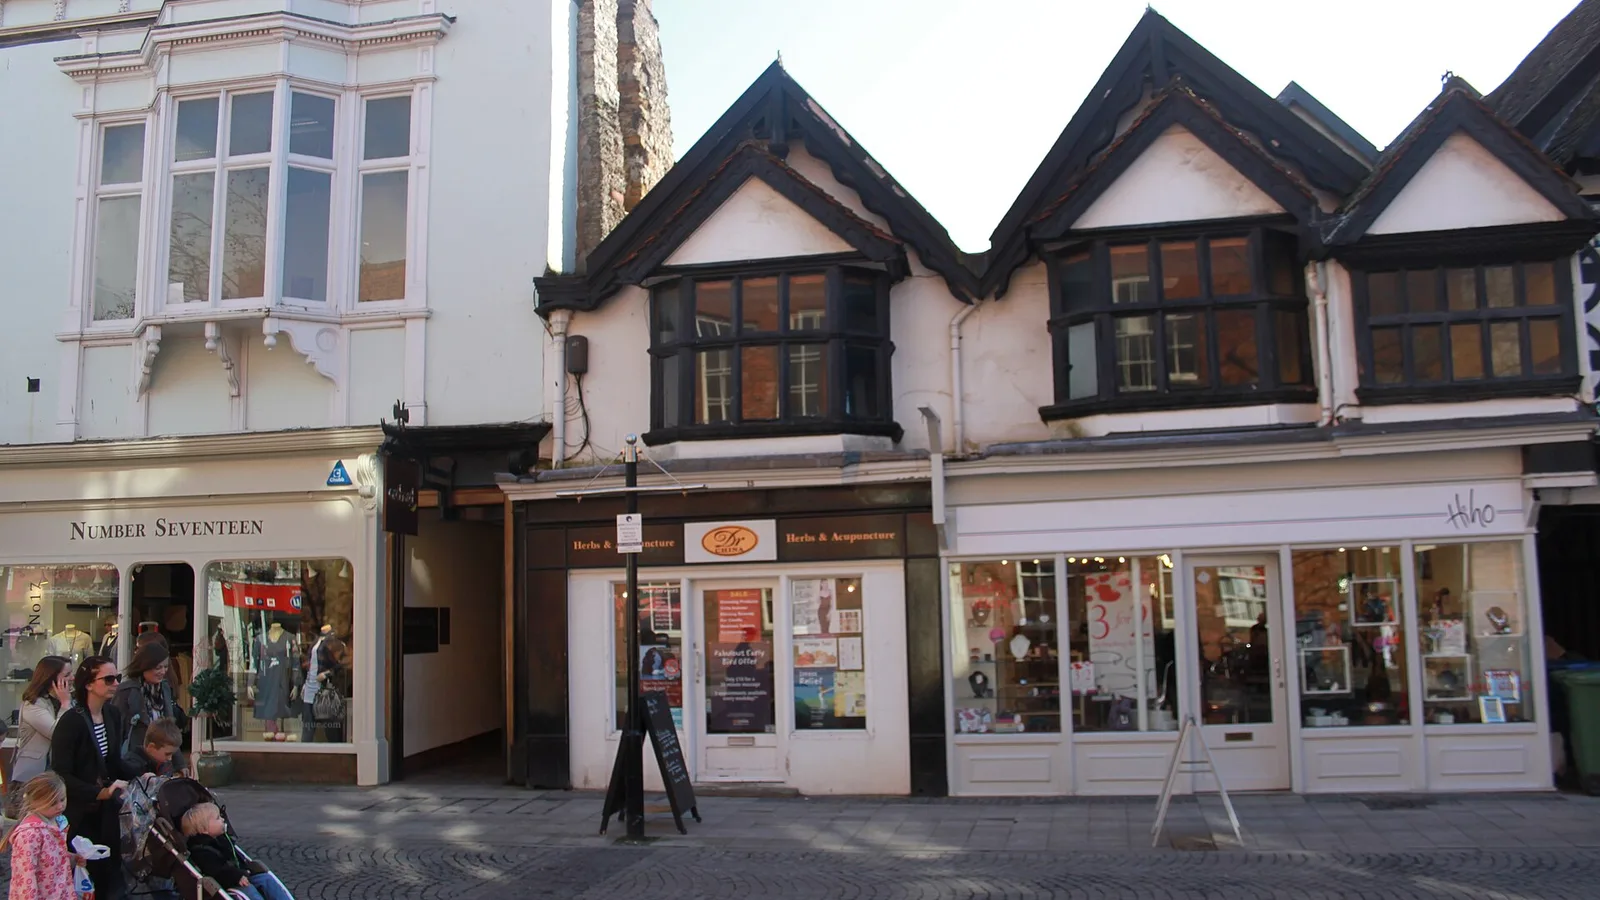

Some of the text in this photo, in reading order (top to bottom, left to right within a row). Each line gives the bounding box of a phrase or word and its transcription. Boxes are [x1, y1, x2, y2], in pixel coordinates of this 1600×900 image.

[1444, 488, 1495, 529] Hiho
[573, 541, 601, 550] Herbs
[603, 540, 611, 549] &
[713, 528, 745, 548] Dr
[786, 532, 895, 544] Herbs & Acupuncture
[1092, 604, 1110, 640] 3
